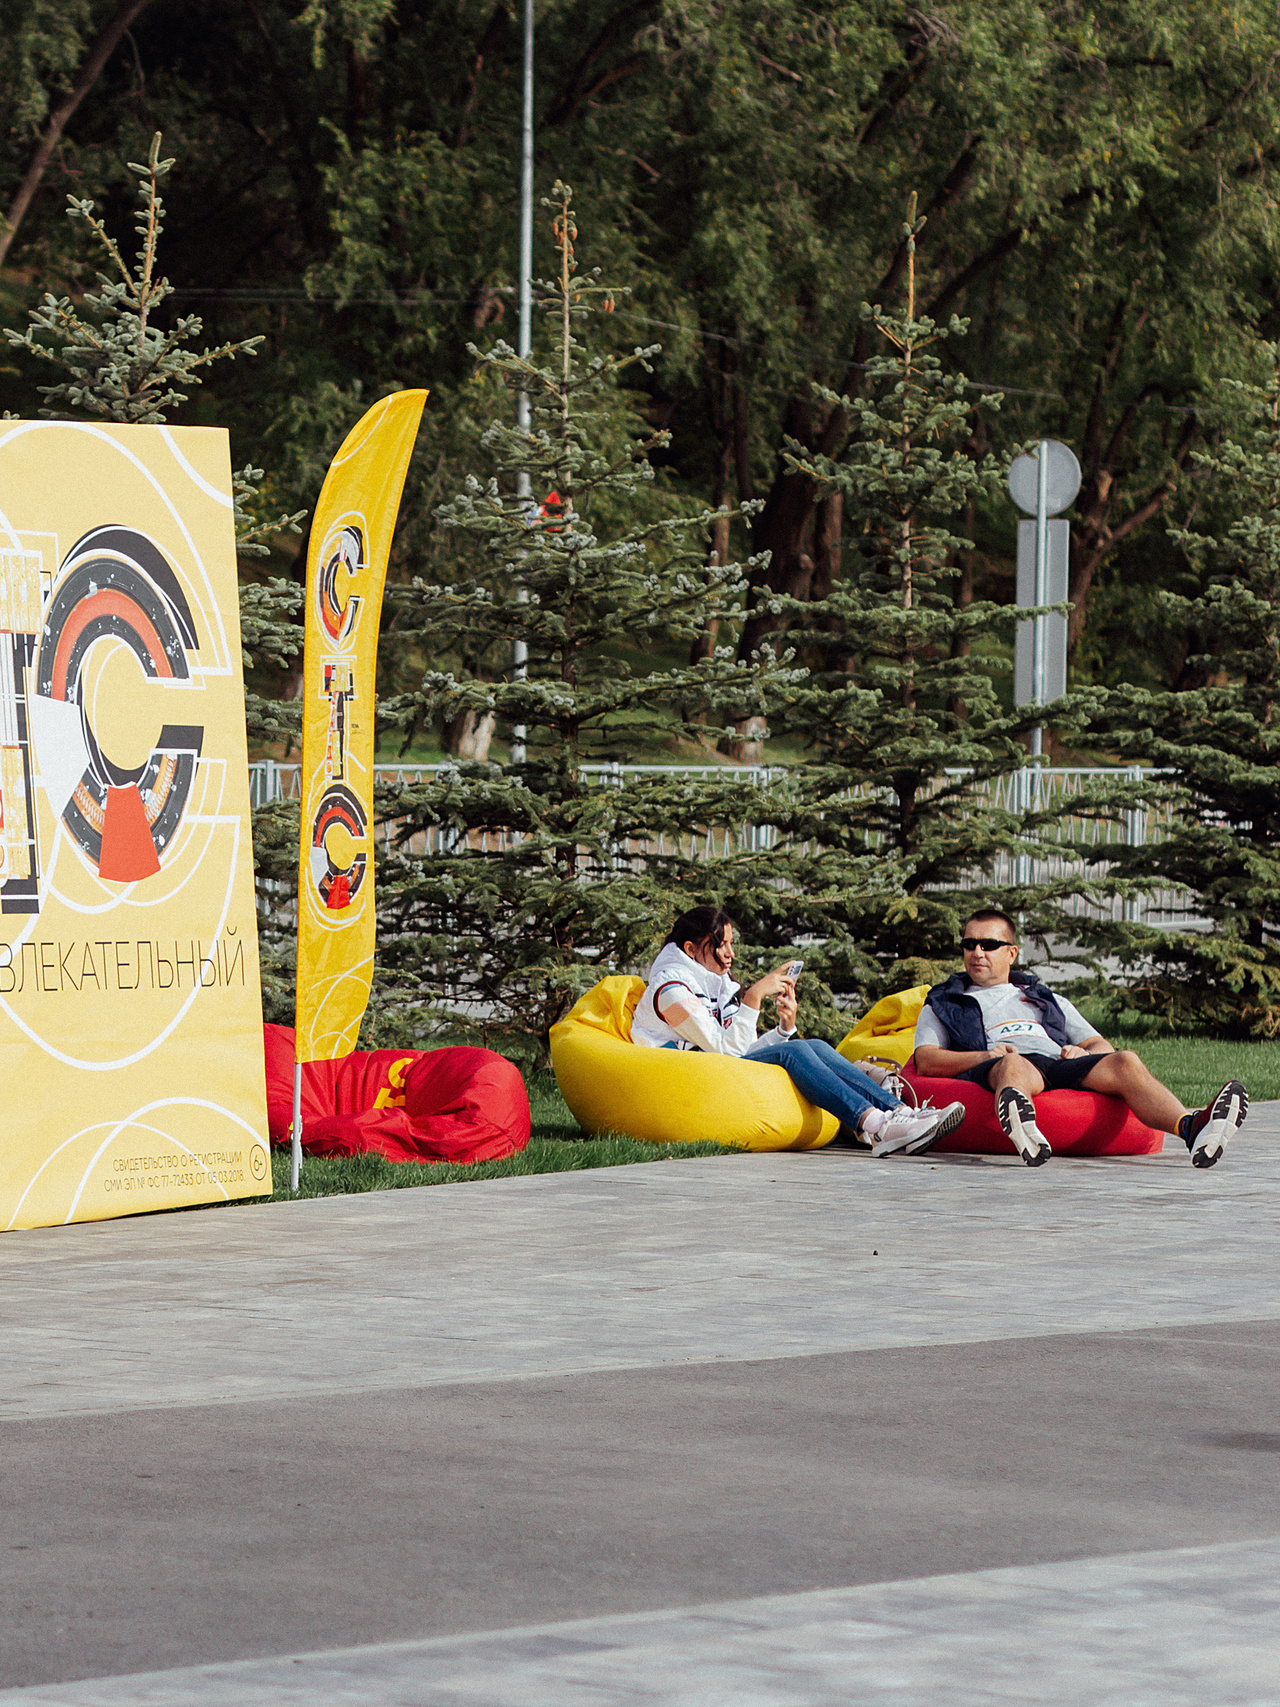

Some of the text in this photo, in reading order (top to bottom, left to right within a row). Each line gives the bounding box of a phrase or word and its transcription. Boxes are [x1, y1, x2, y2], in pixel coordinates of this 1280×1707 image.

[113, 1151, 243, 1173] СВИДЕТЕЛЬСТВО О РЕГИСТРАЦИИ
[104, 1178, 123, 1192] СМИ
[124, 1177, 136, 1190] ЭЛ
[148, 1175, 160, 1188] ФС
[196, 1172, 205, 1185] ОТ
